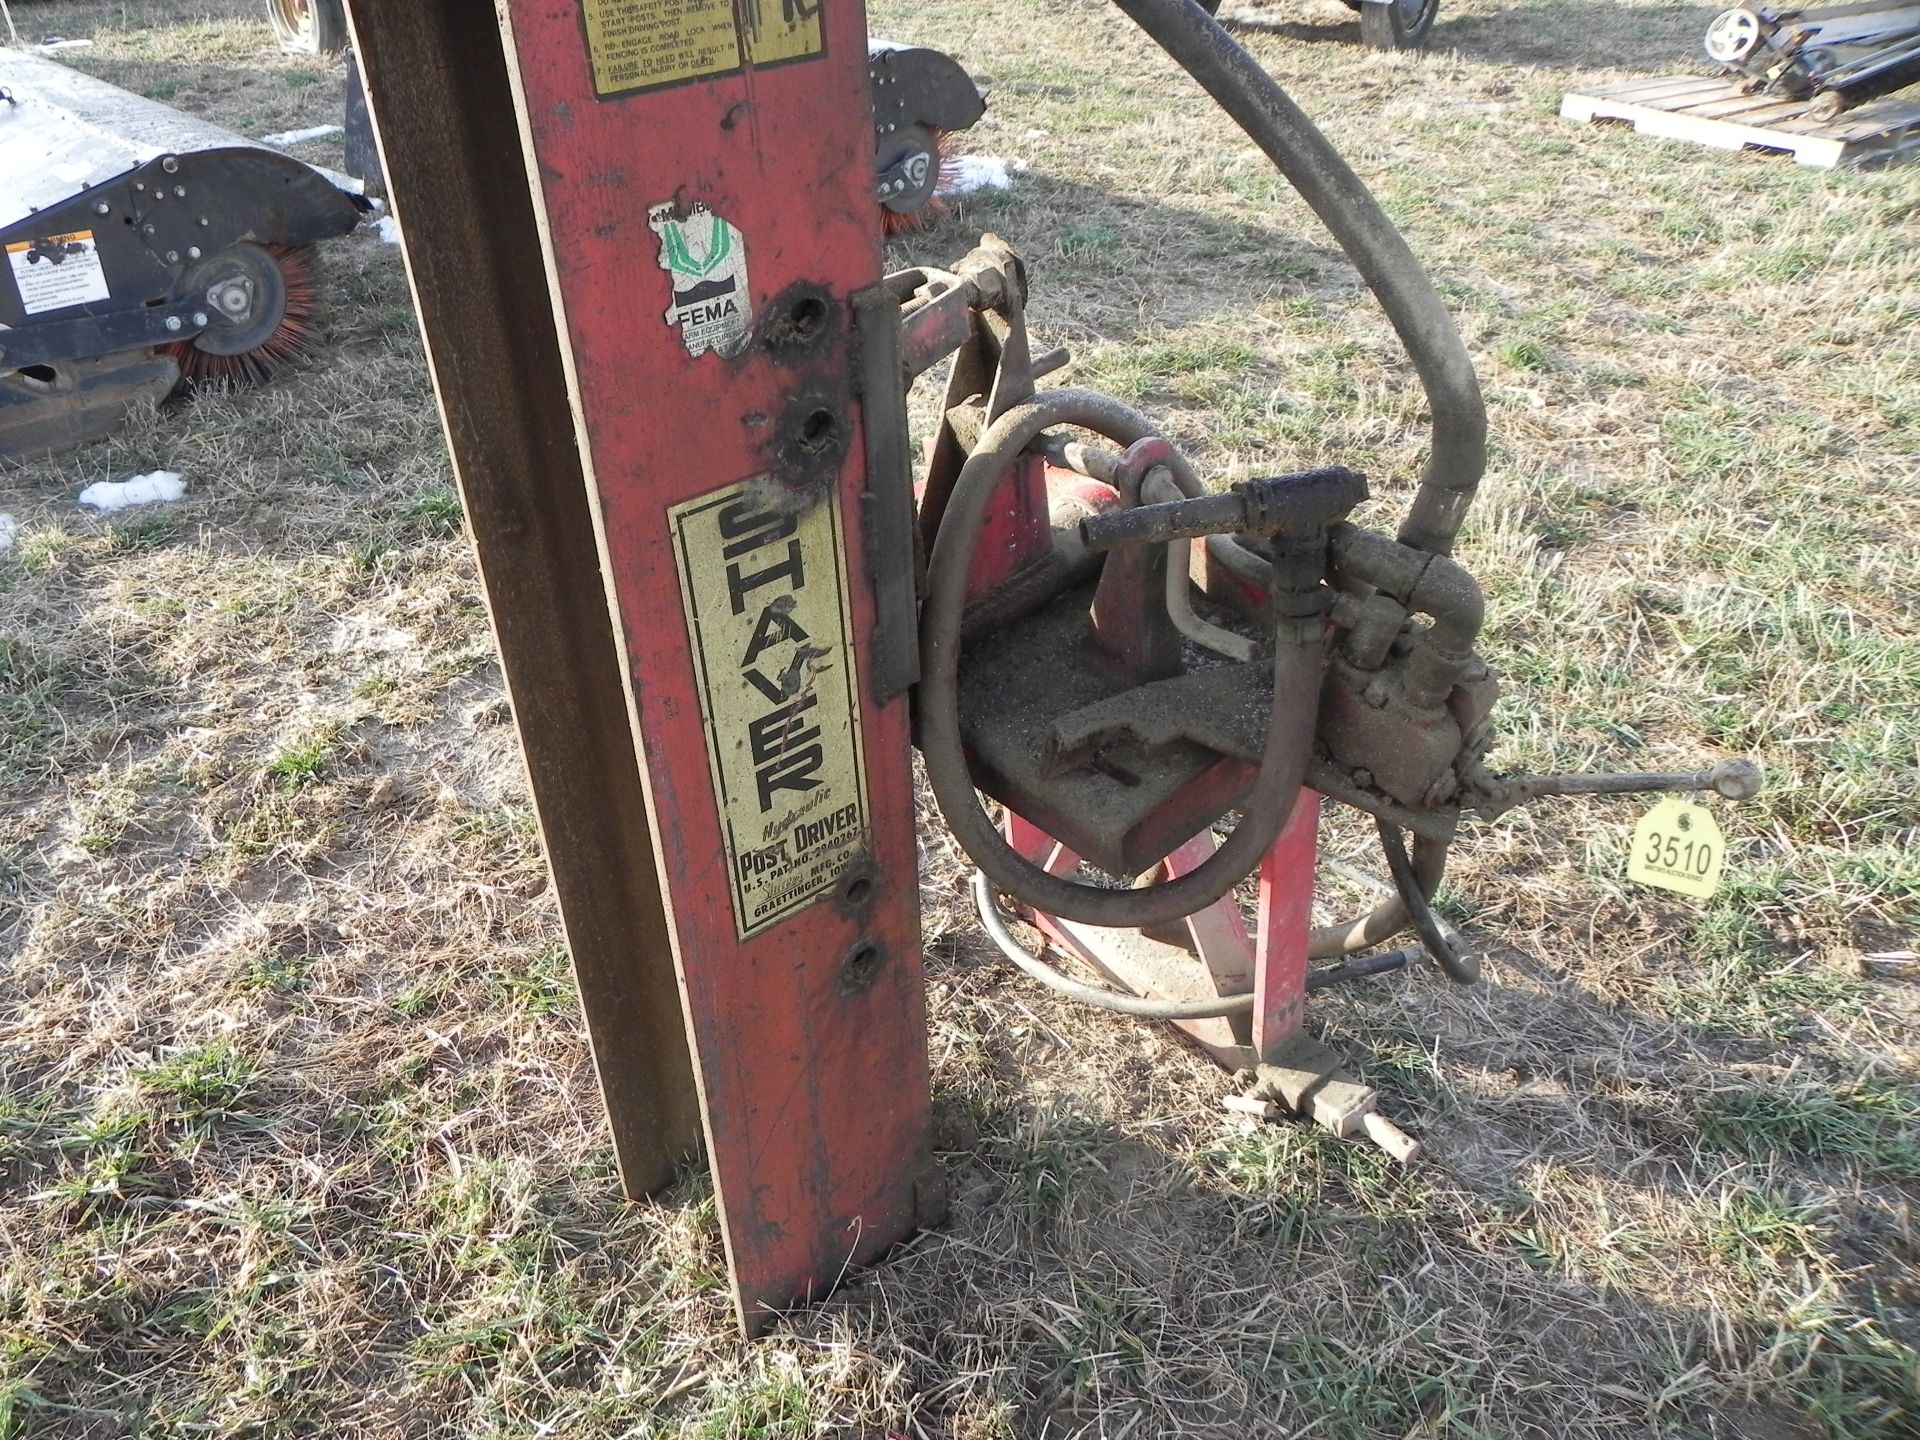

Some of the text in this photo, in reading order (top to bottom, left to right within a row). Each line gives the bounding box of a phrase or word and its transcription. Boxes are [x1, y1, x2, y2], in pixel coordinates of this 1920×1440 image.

[600, 8, 615, 19] USE
[601, 17, 625, 29] START
[664, 7, 683, 17] THEN
[720, 0, 729, 8] TO
[603, 28, 627, 39] FINISH
[628, 21, 660, 34] DRIVING
[659, 31, 680, 42] ROAD
[686, 26, 705, 37] LOCK
[712, 21, 733, 32] WHEN
[606, 49, 639, 61] FENCING
[641, 46, 649, 55] IS
[608, 61, 639, 74] FAILURE
[643, 58, 653, 67] TO
[656, 53, 675, 66] HEED
[679, 50, 695, 60] WILL
[698, 44, 724, 55] RESULT
[728, 42, 735, 50] IN
[610, 69, 650, 83] PERSONAL
[651, 63, 676, 75] INJURY
[679, 61, 689, 70] OR
[677, 299, 739, 326] FEMA
[685, 317, 740, 340] ARM EQUIPMENT
[718, 498, 824, 813] SHAVER
[763, 788, 831, 841] Hydraulic
[1646, 832, 1711, 875] 3510
[811, 859, 835, 877] MFG.
[830, 861, 849, 878] IOW
[744, 878, 768, 894] U.S.
